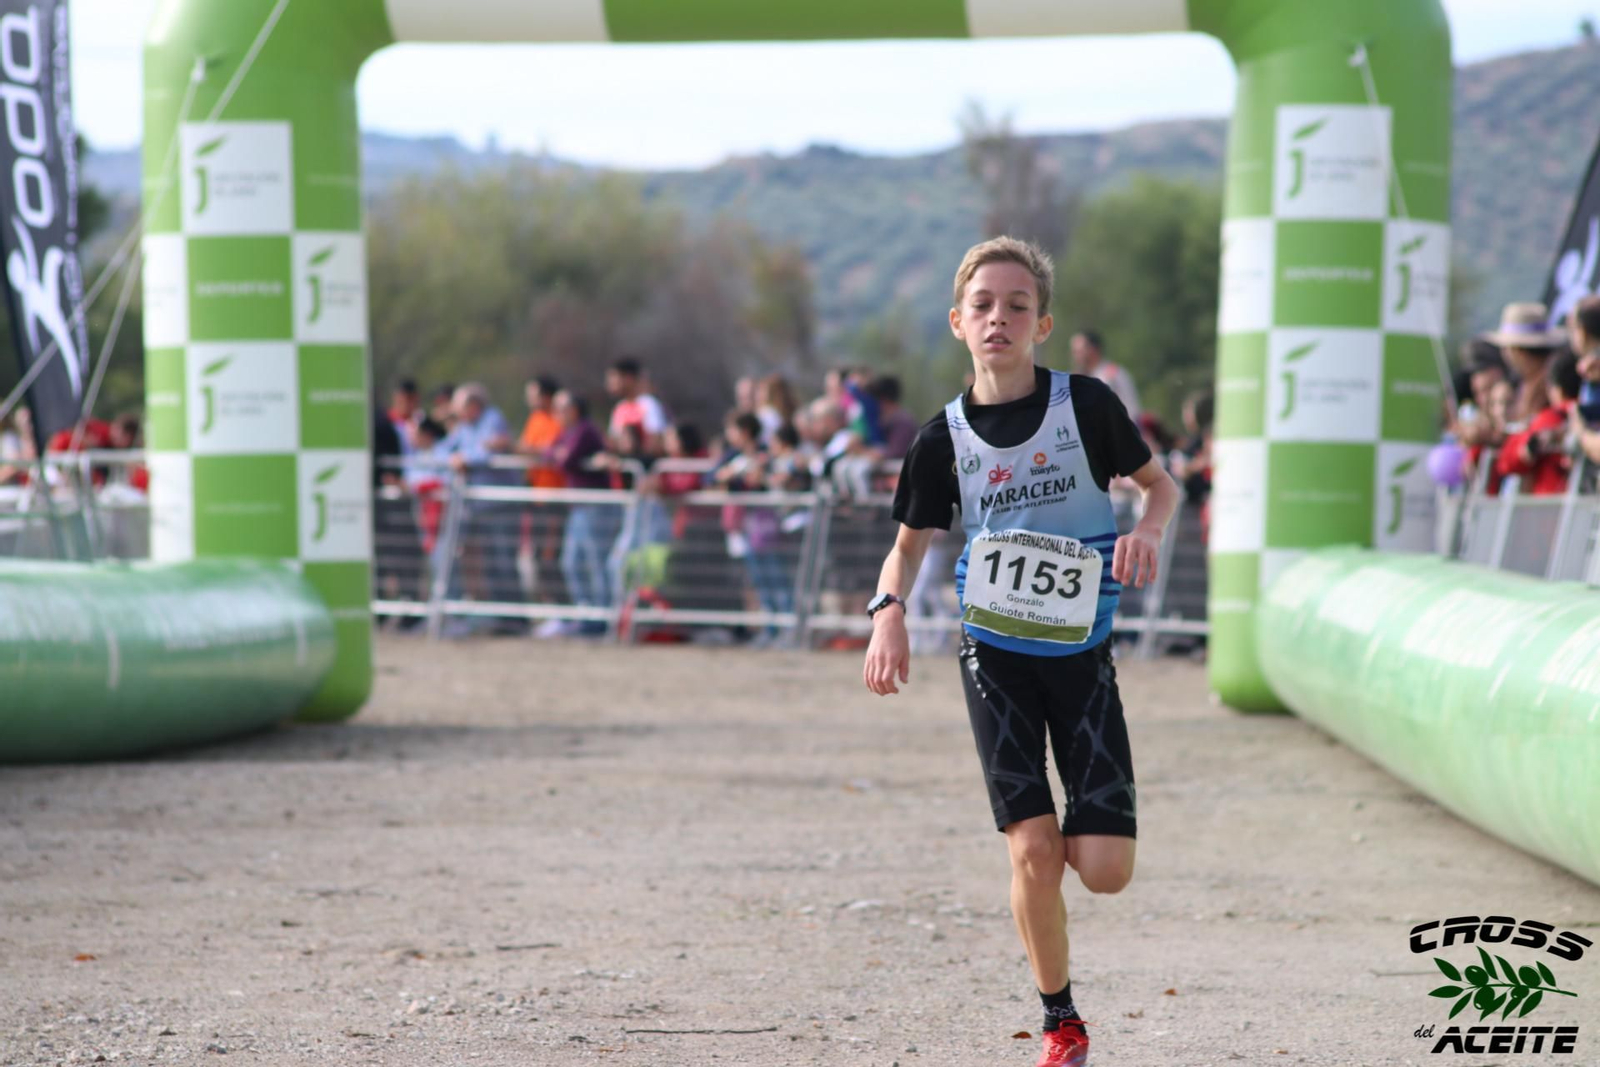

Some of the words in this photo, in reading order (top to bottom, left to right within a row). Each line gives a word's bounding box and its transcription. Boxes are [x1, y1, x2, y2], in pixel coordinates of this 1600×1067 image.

[980, 475, 1077, 511] MARACENA
[1024, 496, 1067, 509] ATLETISMO
[1010, 533, 1063, 555] INTERNACIONAL
[1063, 541, 1076, 558] DEL
[984, 549, 1083, 599] 1153
[1006, 593, 1045, 608] Gonzálo
[989, 601, 1024, 618] Guiote
[1027, 611, 1067, 626] Román
